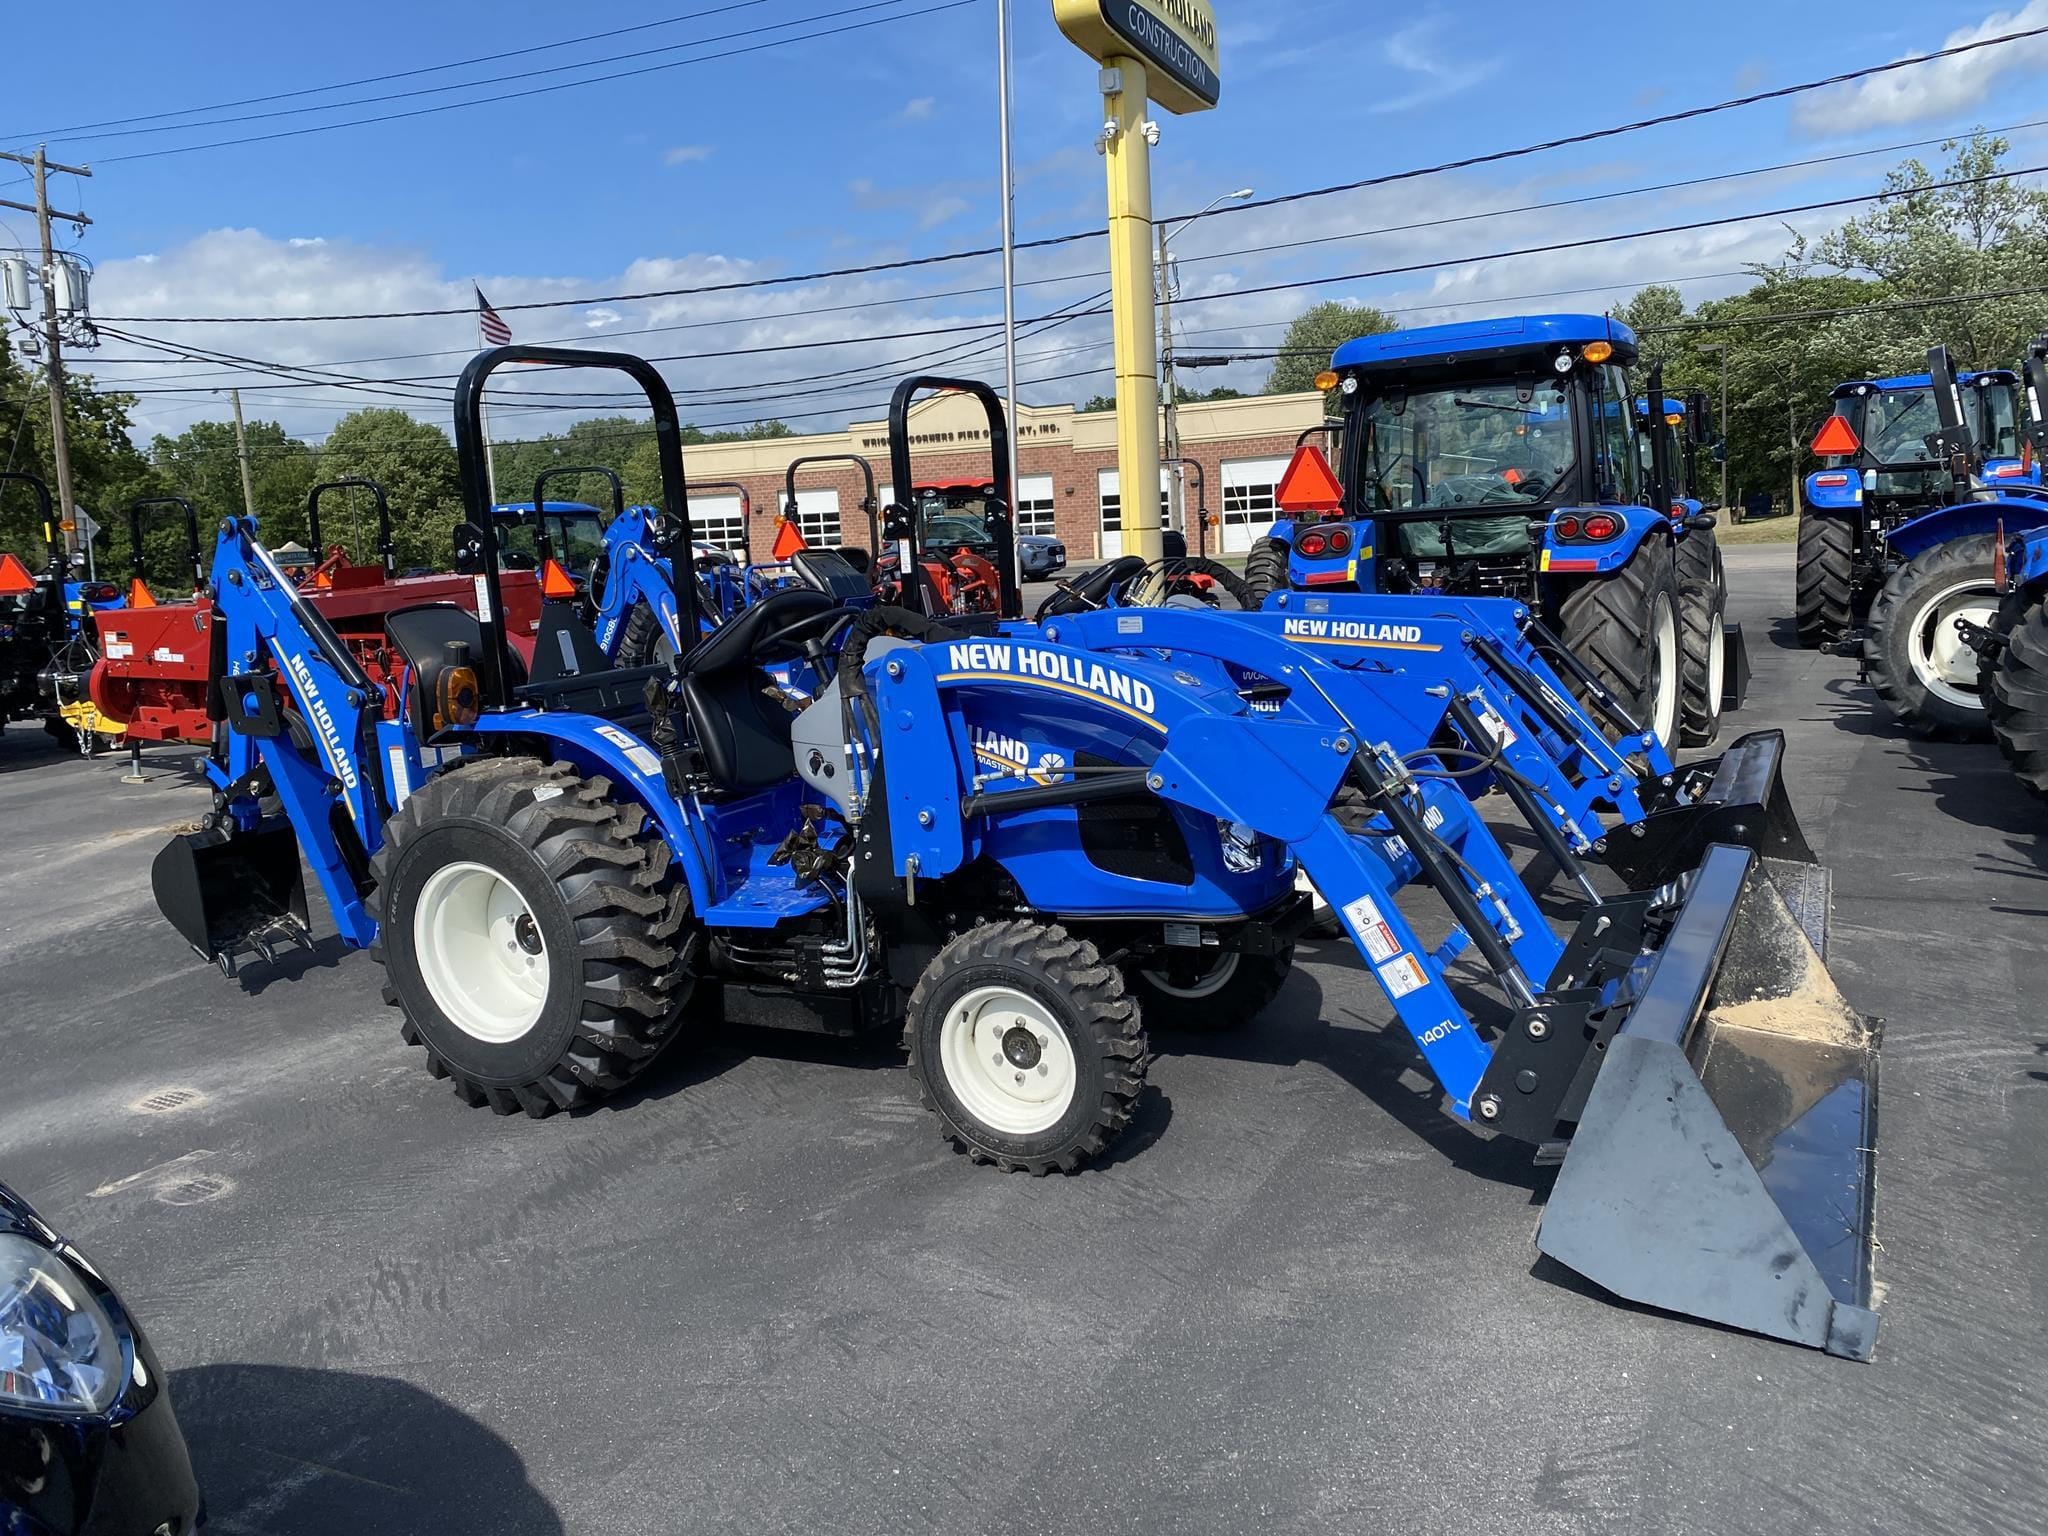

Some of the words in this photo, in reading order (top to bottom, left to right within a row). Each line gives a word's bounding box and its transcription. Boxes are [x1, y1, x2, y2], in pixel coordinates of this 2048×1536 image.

[1157, 0, 1214, 49] OLLAND
[1128, 4, 1206, 86] CONSTRUCTION
[957, 430, 980, 441] FIRE
[1284, 618, 1328, 636] NEW
[1331, 621, 1421, 642] HOLLAND
[949, 644, 1011, 671] NEW
[1017, 646, 1155, 714] HOLLAND
[291, 653, 320, 698] NEW
[313, 699, 357, 789] HOLLAND
[1250, 700, 1281, 713] HOLL
[1418, 1019, 1461, 1046] 140TL
